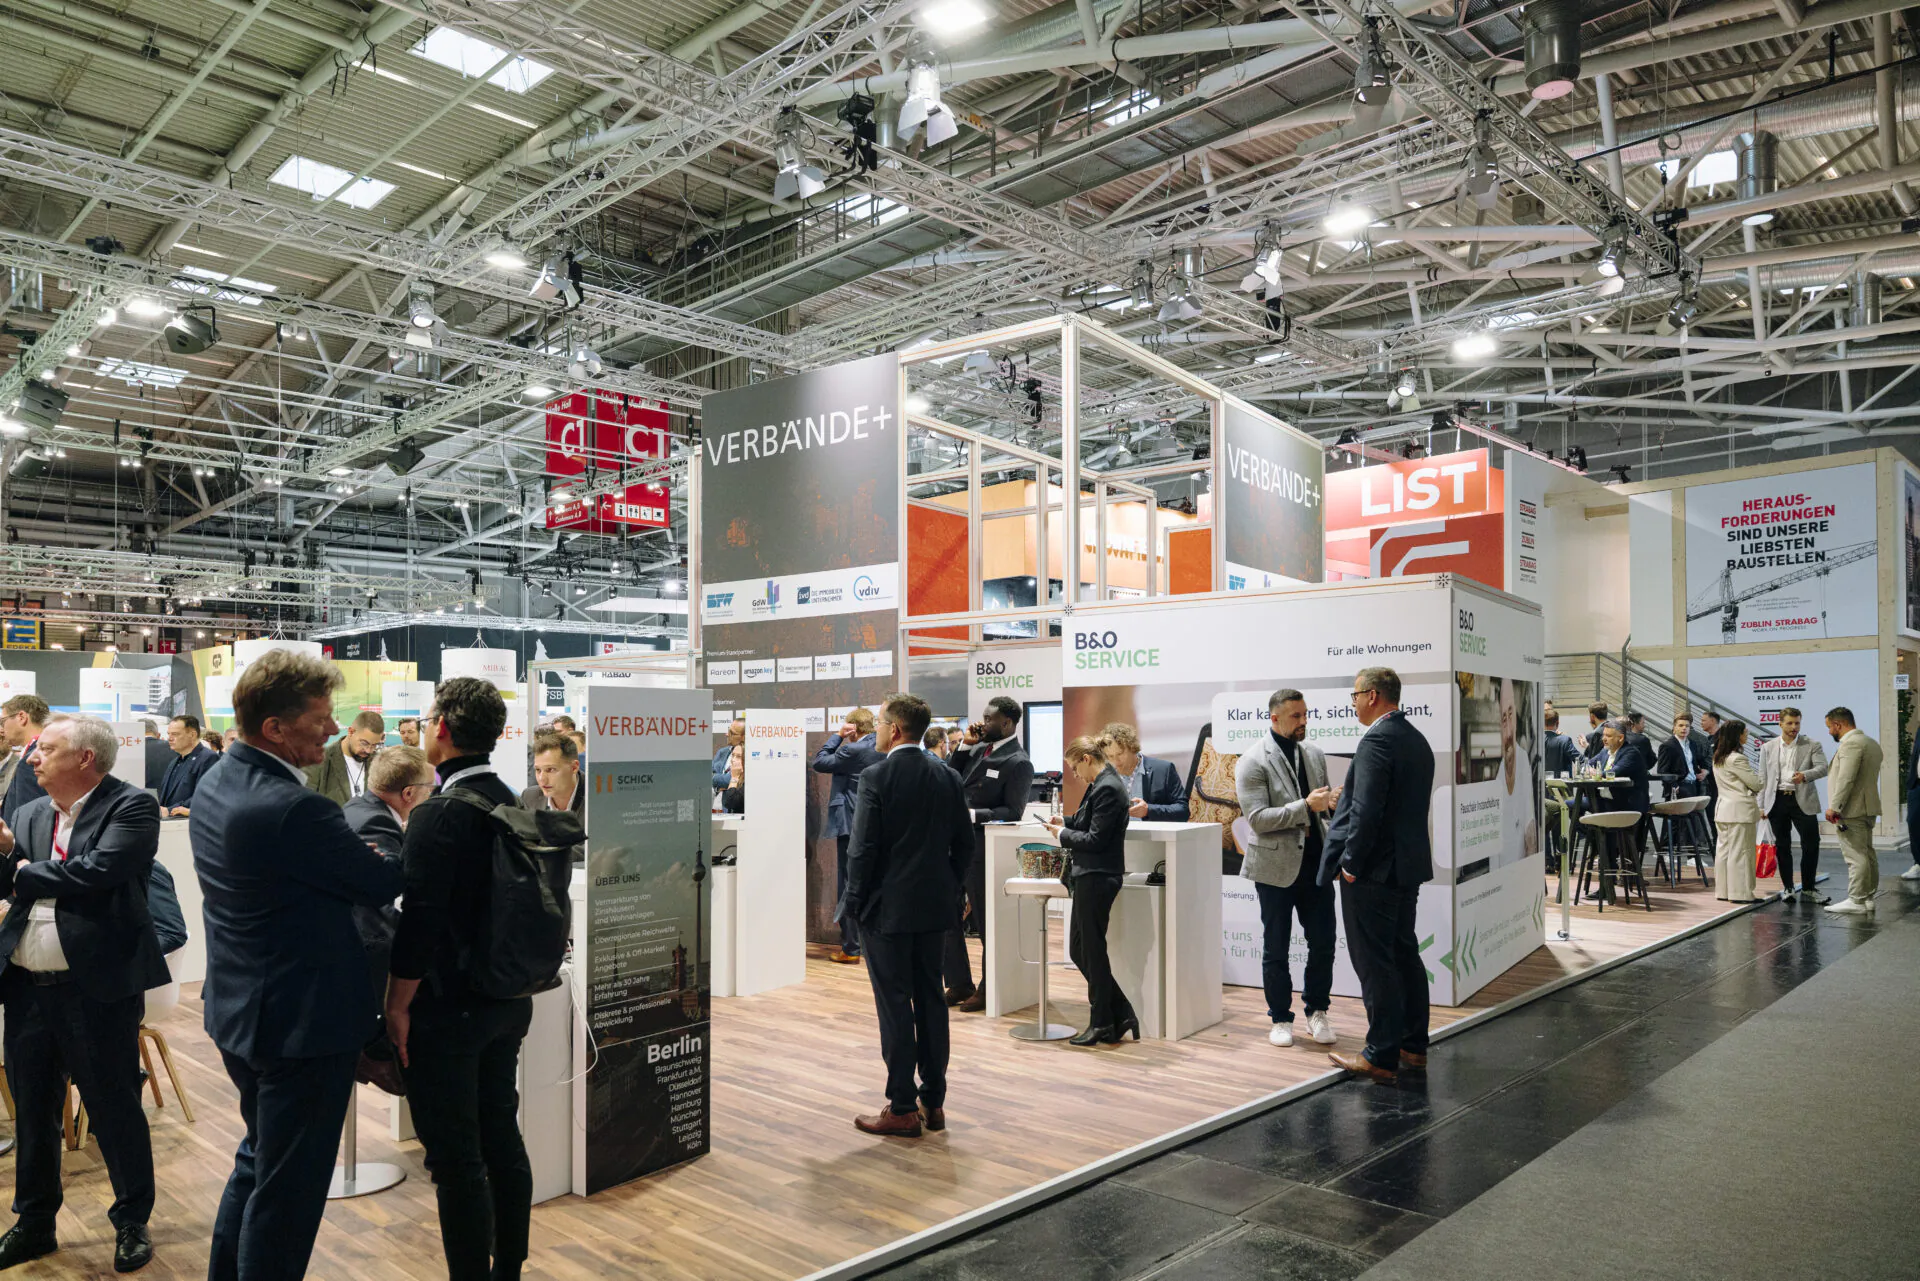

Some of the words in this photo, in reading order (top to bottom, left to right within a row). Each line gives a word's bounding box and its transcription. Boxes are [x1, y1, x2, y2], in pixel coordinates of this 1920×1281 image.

[706, 405, 892, 466] VERBÄNDE+
[1228, 443, 1321, 508] VERBÄNDE+
[1361, 461, 1477, 517] LIST
[1743, 493, 1812, 512] HERAUS-
[1721, 505, 1836, 528] FORDERUNGEN
[1727, 527, 1762, 542] SIND
[1766, 520, 1829, 538] UNSERE
[1741, 537, 1815, 555] LIEBSTEN
[1727, 551, 1831, 571] BAUSTELLEN.
[859, 586, 880, 597] vdiv
[1459, 609, 1474, 631] B&O
[1741, 620, 1772, 629] ZÜBLIN
[1775, 617, 1818, 627] STRABAG
[1075, 631, 1118, 650] B&O
[1459, 632, 1487, 656] SERVICE
[1327, 646, 1343, 656] Für
[1346, 645, 1364, 655] alle
[1367, 641, 1432, 654] Wohnungen
[1075, 648, 1160, 670] SERVICE
[976, 662, 1006, 675] B&O
[976, 675, 1034, 689] SERVICE
[1753, 678, 1806, 689] STRABAG
[1227, 709, 1253, 721] Klar
[594, 716, 708, 736] VERBÄNDE+
[749, 725, 804, 738] VERBÄNDE+
[1227, 728, 1267, 742] genau
[617, 774, 653, 784] SCHICK
[595, 875, 620, 886] ÜBER
[622, 873, 641, 883] UNS
[595, 895, 639, 906] Vermarktung
[640, 893, 651, 901] von
[595, 905, 635, 916] Zinshäusern
[595, 917, 609, 925] und
[610, 910, 655, 923] Wohnanlagen
[595, 931, 640, 944] Überregionale
[642, 924, 676, 936] Reichweite
[1232, 932, 1252, 941] uns
[595, 952, 626, 964] Exklusive
[1231, 946, 1247, 958] für
[594, 961, 628, 973] Angebote
[594, 983, 611, 992] Mehr
[623, 979, 632, 987] 30
[633, 975, 650, 984] Jahre
[594, 988, 628, 1001] Erfahrung
[594, 1008, 621, 1020] Diskrete
[629, 997, 672, 1013] professionelle
[594, 1015, 633, 1029] Abwicklung
[647, 1033, 701, 1064] Berlin
[655, 1056, 702, 1075] Braunschweig
[657, 1069, 688, 1085] Frankfurt
[668, 1076, 702, 1092] Düsseldorf
[670, 1087, 702, 1102] Hannover
[671, 1097, 702, 1113] Hamburg
[670, 1108, 702, 1124] München
[672, 1119, 702, 1134] Stuttgart
[678, 1129, 702, 1144] Leipzig
[687, 1140, 702, 1151] Köln
